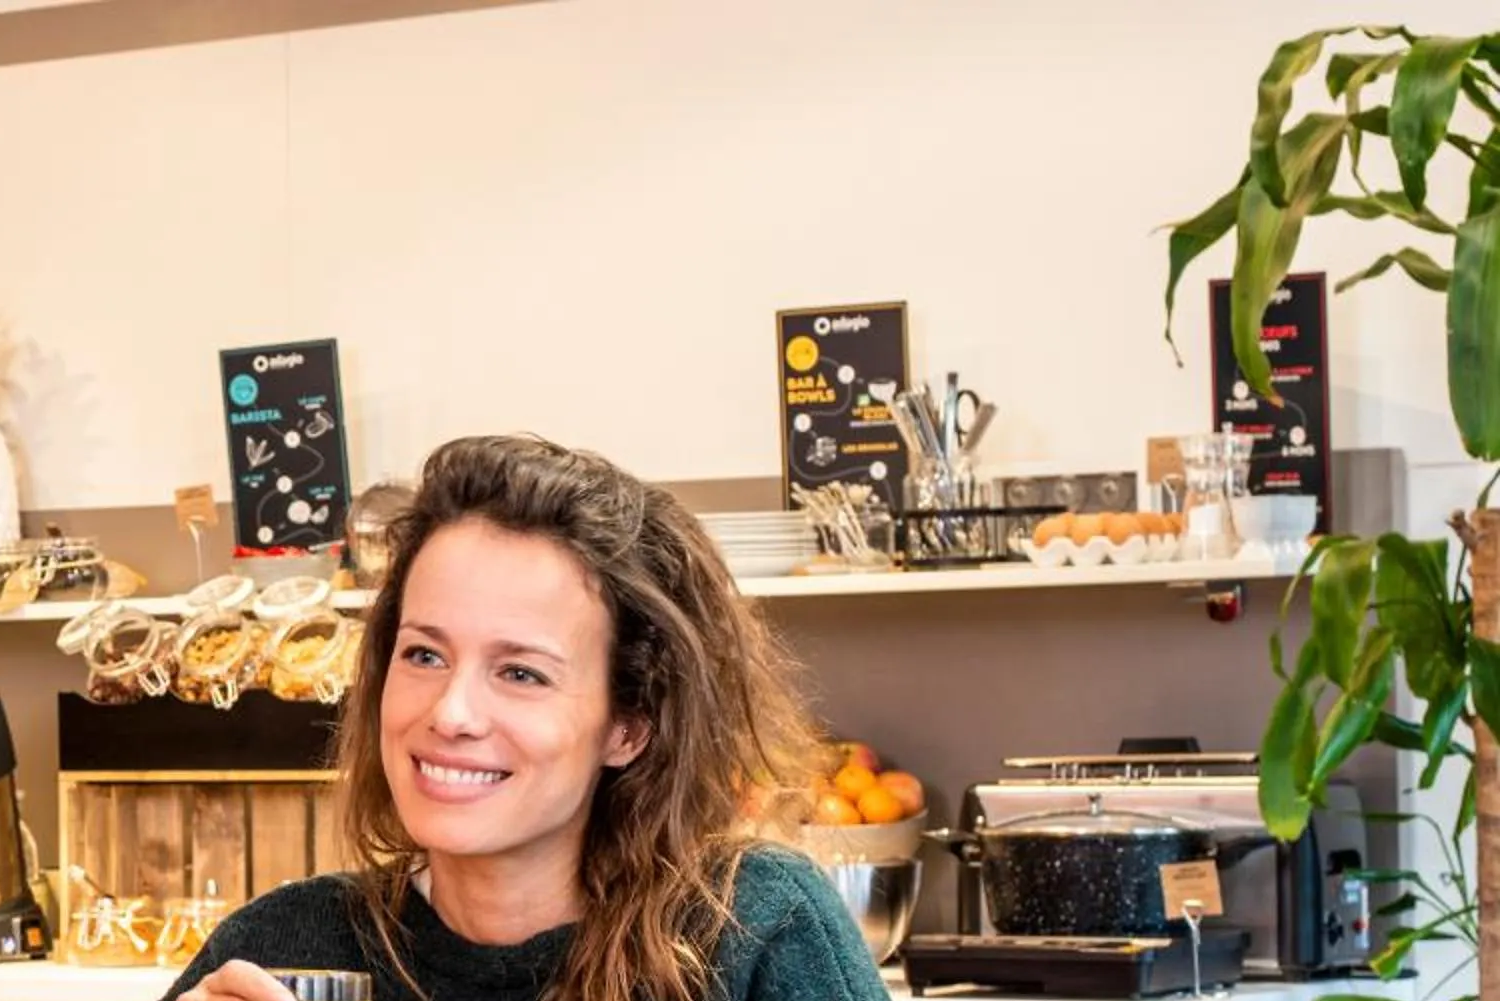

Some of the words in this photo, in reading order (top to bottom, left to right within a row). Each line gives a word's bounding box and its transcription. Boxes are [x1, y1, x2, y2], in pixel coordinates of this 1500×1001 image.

[787, 376, 814, 389] BAR
[787, 389, 836, 404] BOWLS
[231, 409, 281, 424] BARISTA
